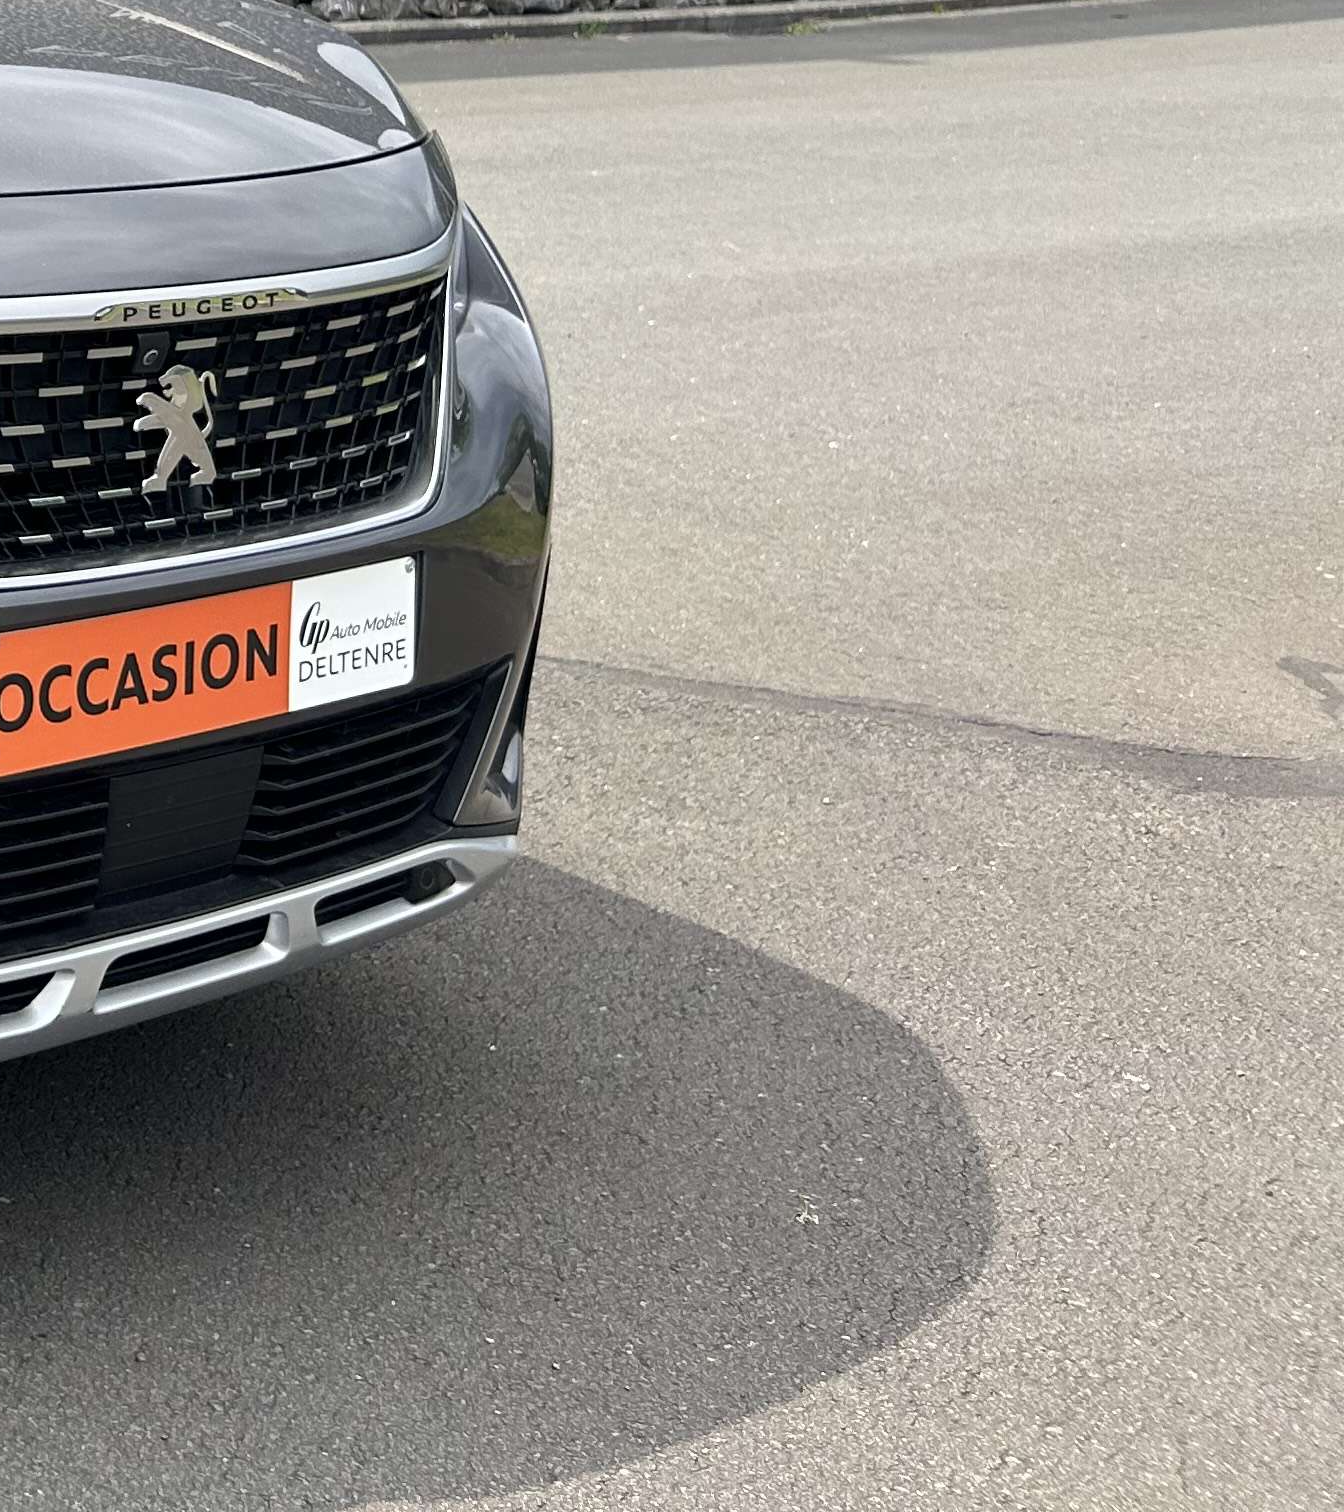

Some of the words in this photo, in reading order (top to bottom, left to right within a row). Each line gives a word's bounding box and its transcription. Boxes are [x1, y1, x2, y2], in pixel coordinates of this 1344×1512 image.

[122, 292, 279, 322] PEUGEOT
[331, 623, 361, 639] Auto
[363, 611, 407, 633] Mobile
[299, 639, 406, 682] DELTENRE
